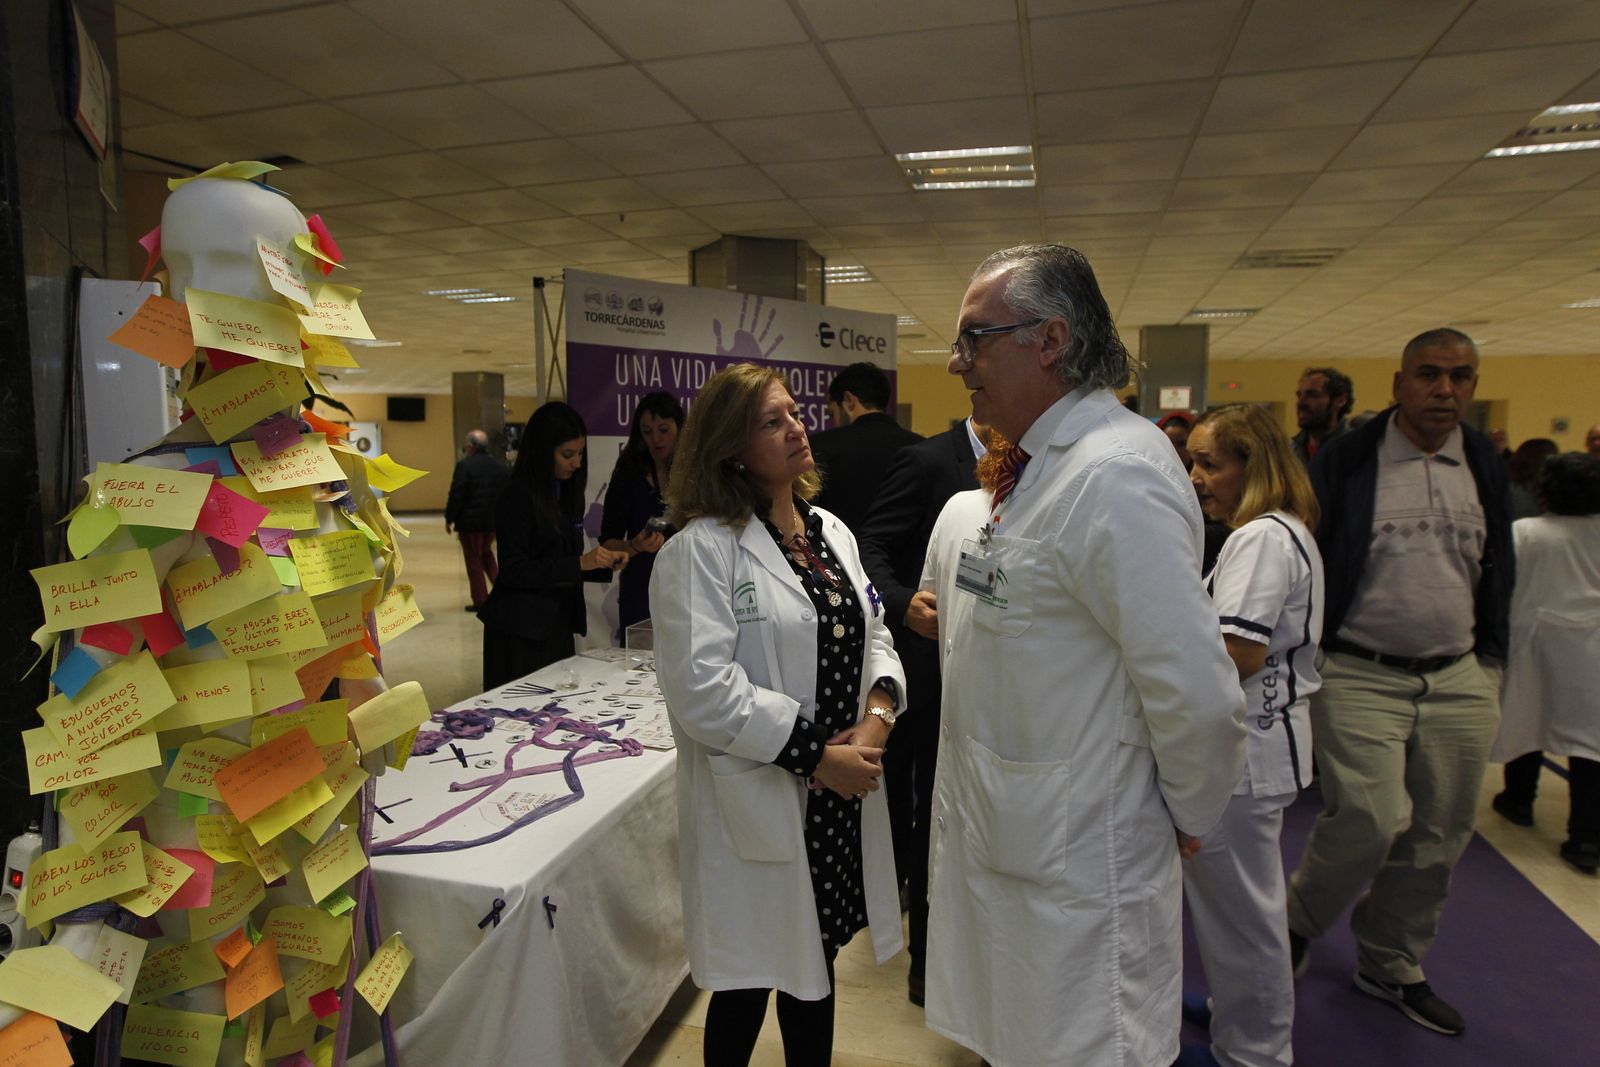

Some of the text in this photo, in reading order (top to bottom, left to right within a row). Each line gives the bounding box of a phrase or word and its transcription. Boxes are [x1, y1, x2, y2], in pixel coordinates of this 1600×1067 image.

[584, 310, 666, 330] TORRECÁRDENAS
[221, 330, 242, 342] ME
[840, 327, 887, 354] Clece
[615, 353, 662, 388] UNA
[103, 478, 180, 494] FUERA EL
[259, 476, 273, 486] ME
[51, 570, 138, 599] BRILLA JUNTO
[54, 596, 101, 616] A ELLA
[222, 638, 236, 647] EL
[284, 622, 294, 632] DE
[299, 616, 315, 627] LAS
[225, 607, 310, 637] SI ABUSAS ERES
[231, 637, 282, 655] ESPECIES
[195, 684, 231, 699] MENOS
[66, 693, 140, 747] A NUESTROS
[44, 767, 98, 788] COLOR
[99, 783, 120, 800] POR
[84, 801, 124, 833] COLOR
[31, 842, 137, 890] CABEN LOS BESOS
[31, 860, 129, 909] NO LOS GOLPES
[271, 930, 320, 945] HUMANOS
